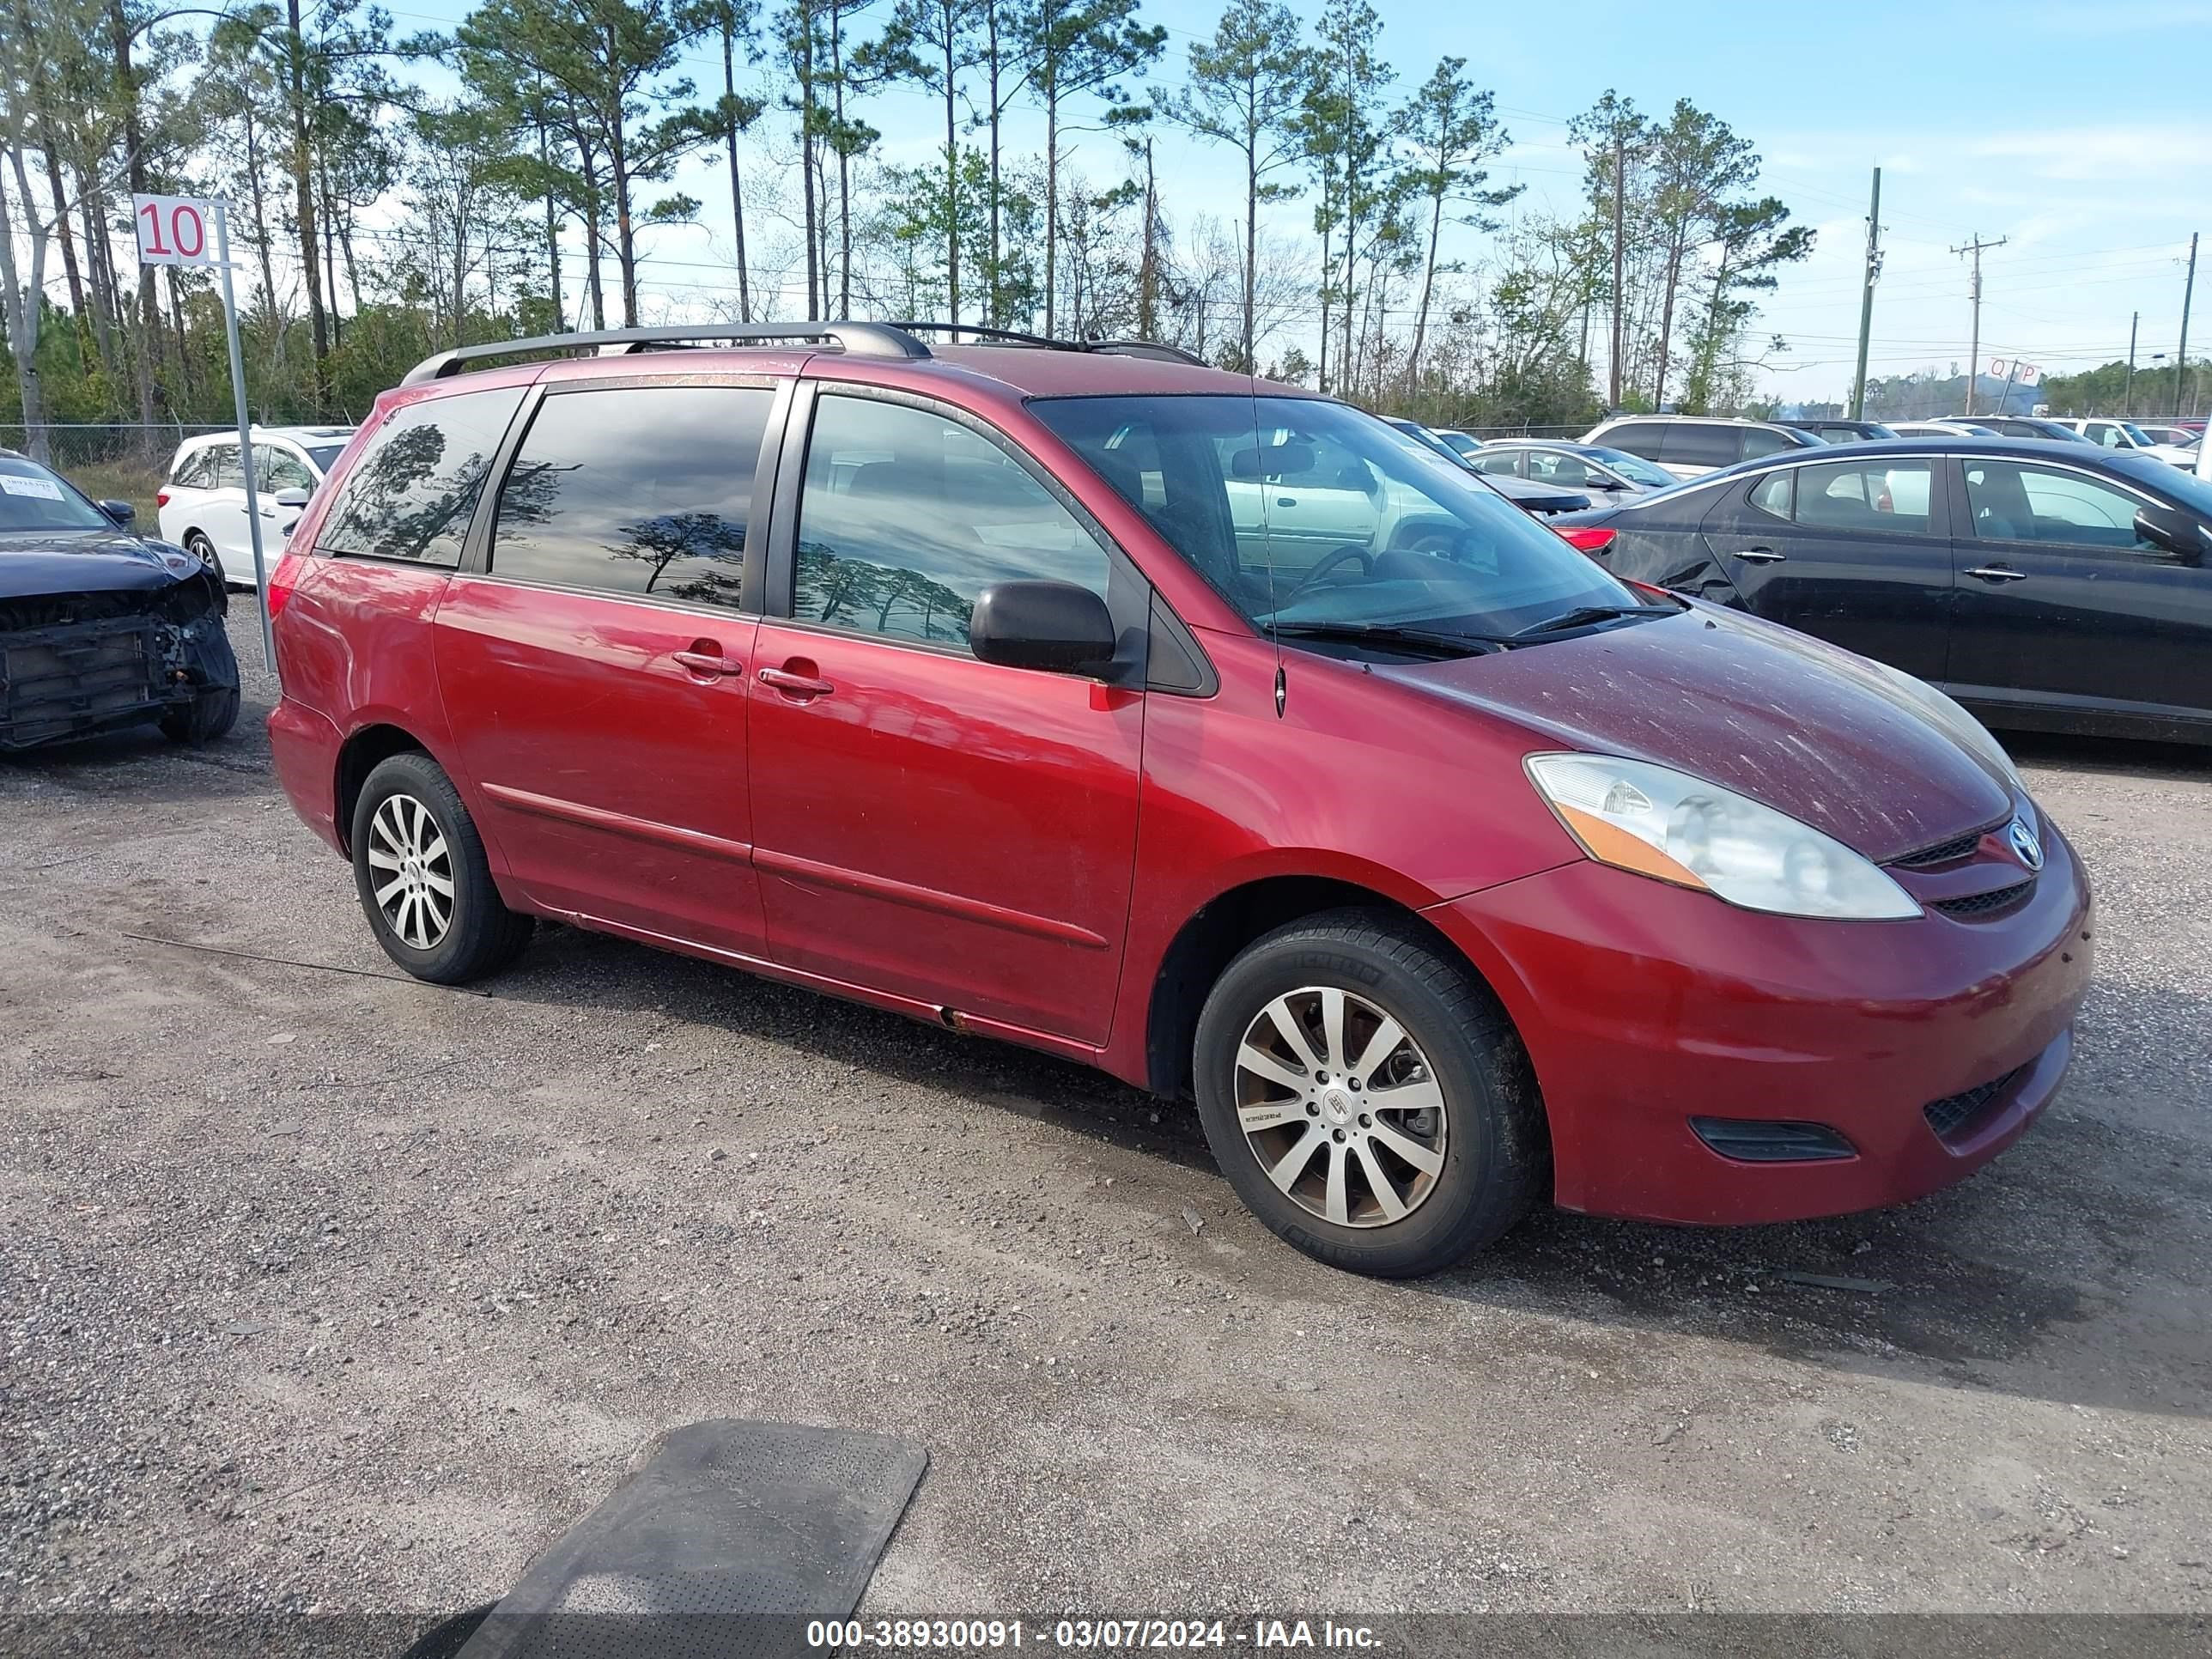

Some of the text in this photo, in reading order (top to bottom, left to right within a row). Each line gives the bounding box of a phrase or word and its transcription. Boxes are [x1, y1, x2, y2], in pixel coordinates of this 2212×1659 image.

[140, 204, 204, 257] 10
[1991, 359, 2005, 378] Q
[2022, 367, 2035, 381] P
